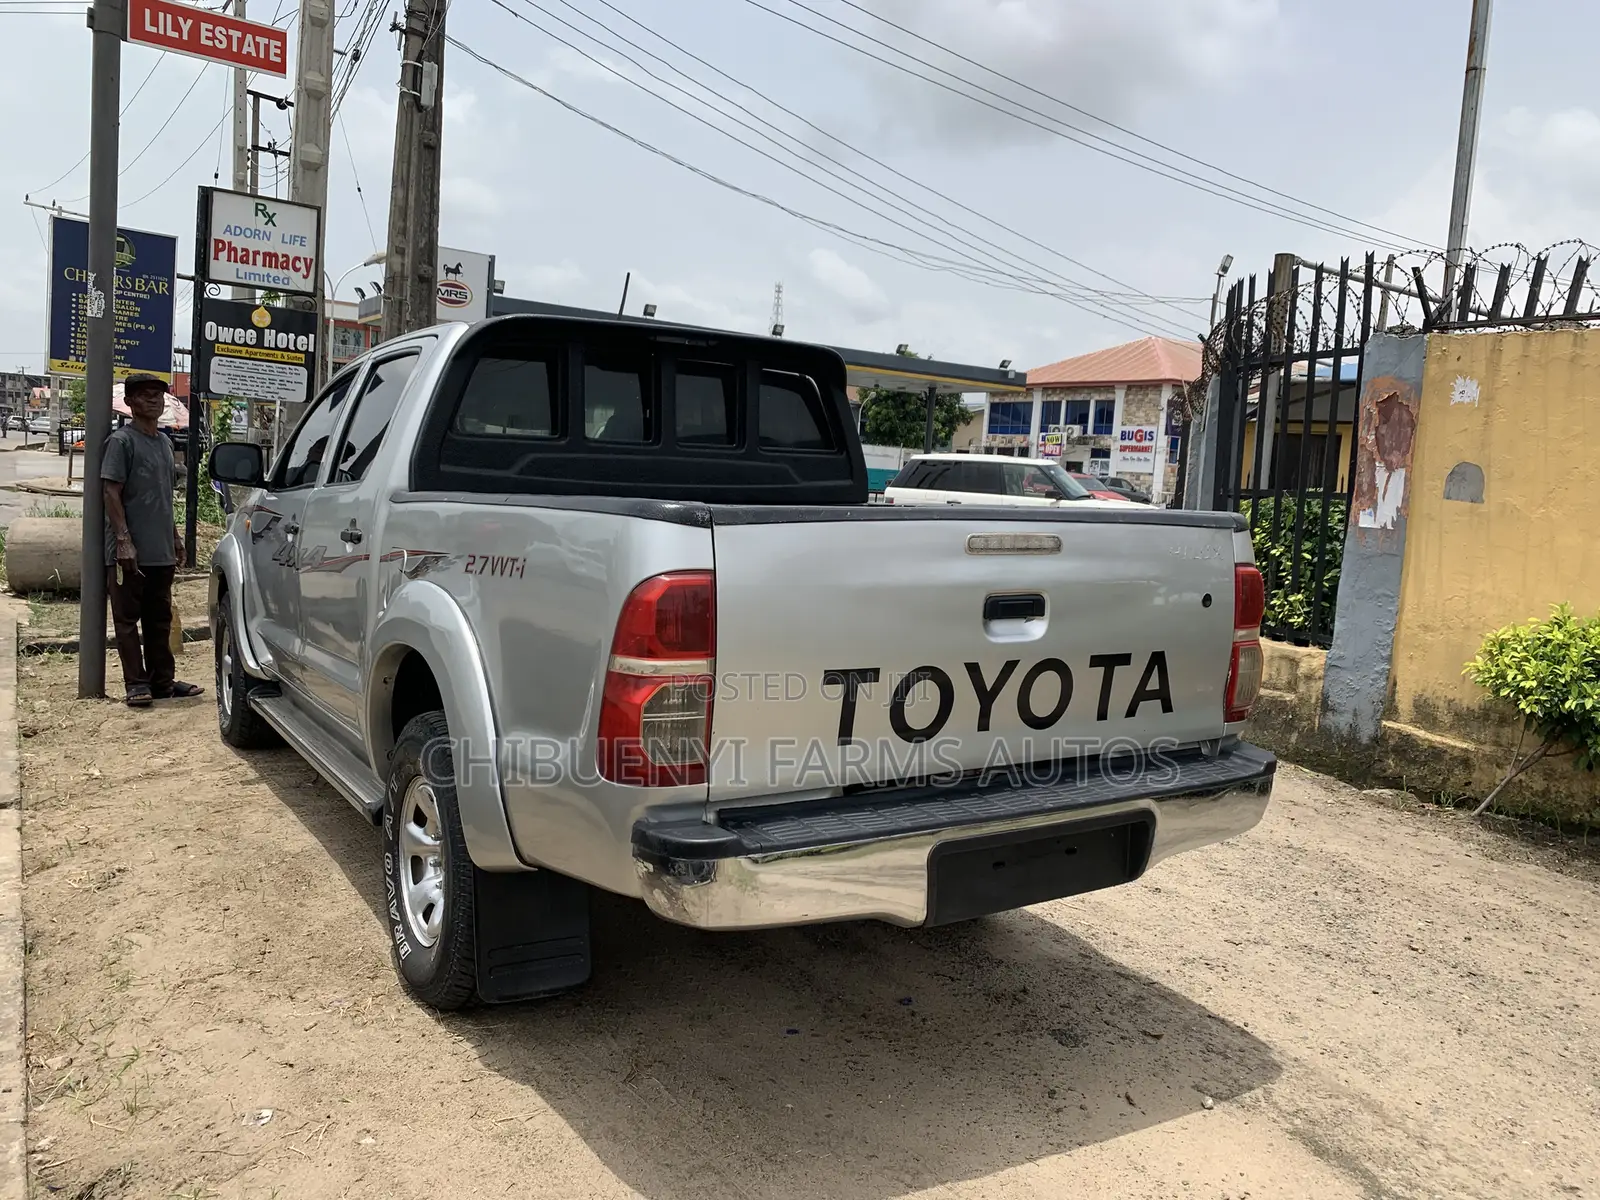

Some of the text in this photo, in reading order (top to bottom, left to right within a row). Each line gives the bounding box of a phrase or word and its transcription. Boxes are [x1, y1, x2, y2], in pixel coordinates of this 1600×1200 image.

[144, 8, 282, 63] LILY ESTATE
[223, 224, 307, 248] ADORN LIFE
[212, 238, 314, 280] Pharmacy
[235, 267, 291, 286] Limited
[135, 277, 170, 296] BAR
[437, 287, 468, 300] MRS
[204, 321, 315, 353] Owee Hotel
[216, 345, 243, 355] Exclusive
[244, 348, 279, 360] Apartments
[286, 353, 304, 362] Suites
[1046, 435, 1060, 444] NOW
[1120, 428, 1154, 443] BUGIS
[1119, 445, 1153, 453] SUPERMARKET
[823, 650, 1174, 747] TOYOTA
[384, 851, 412, 961] BRAVO
